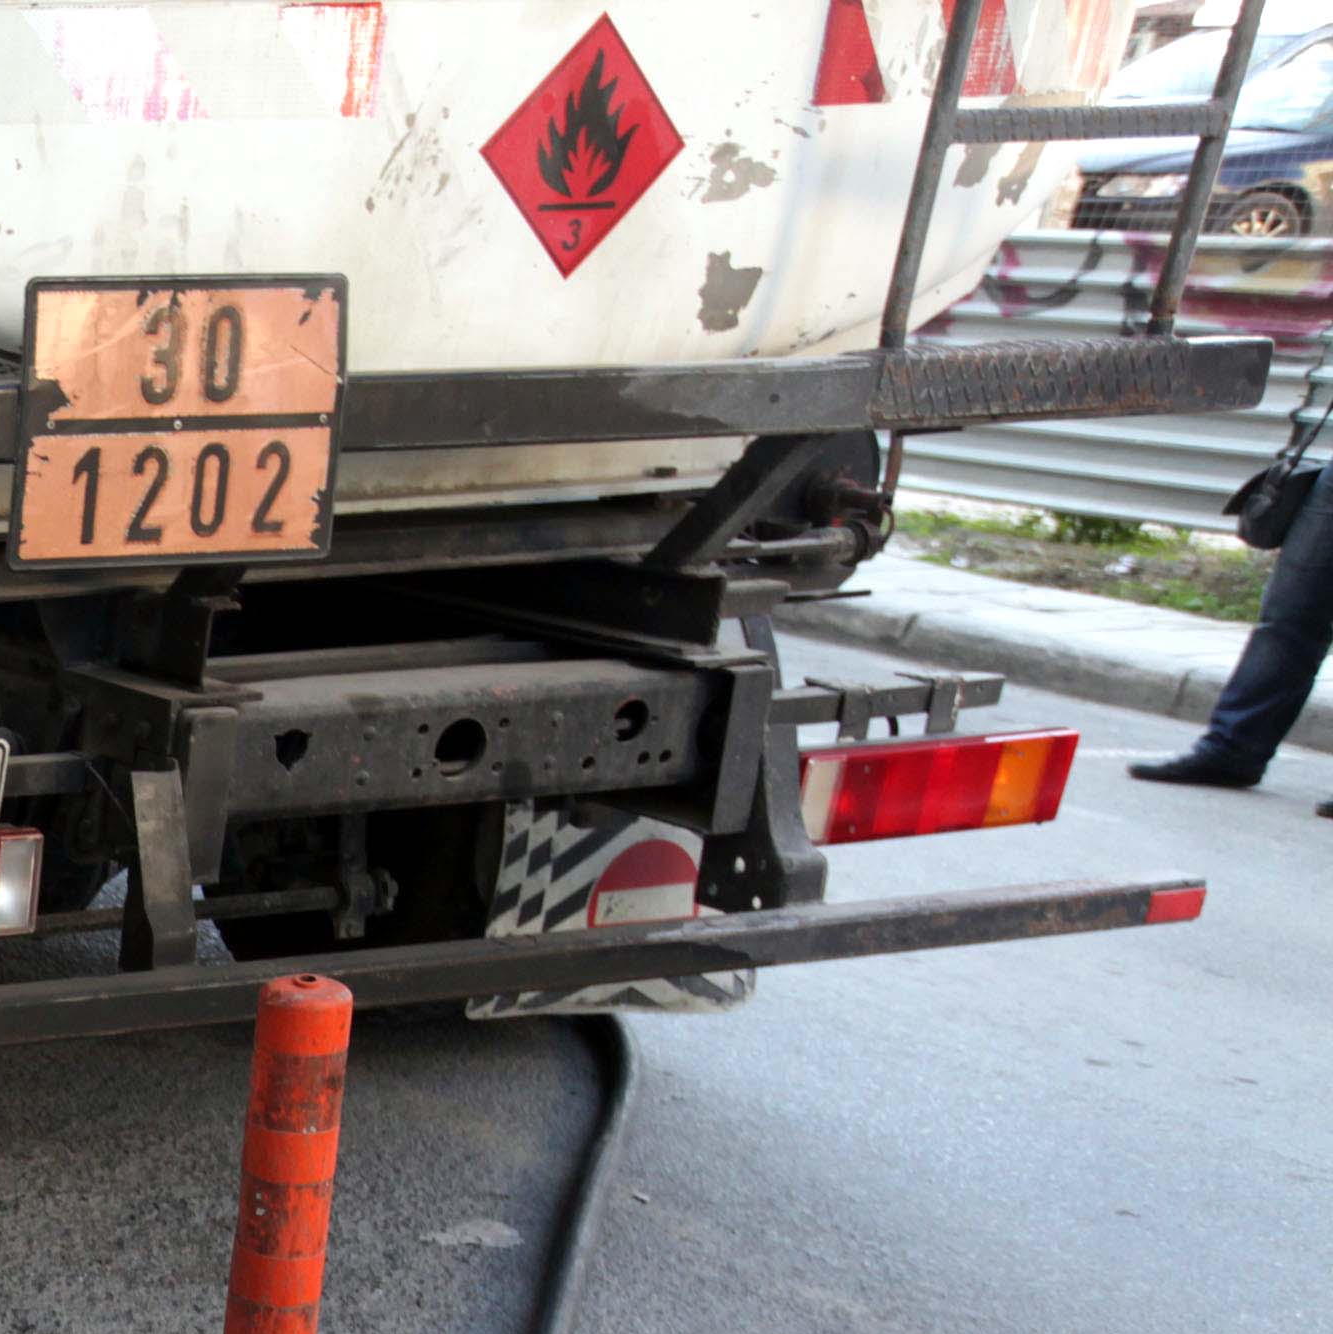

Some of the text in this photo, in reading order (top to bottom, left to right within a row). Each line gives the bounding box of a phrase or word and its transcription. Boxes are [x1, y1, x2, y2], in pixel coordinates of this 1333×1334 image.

[561, 219, 582, 252] 3
[140, 304, 244, 405] 30
[71, 441, 291, 545] 1202
